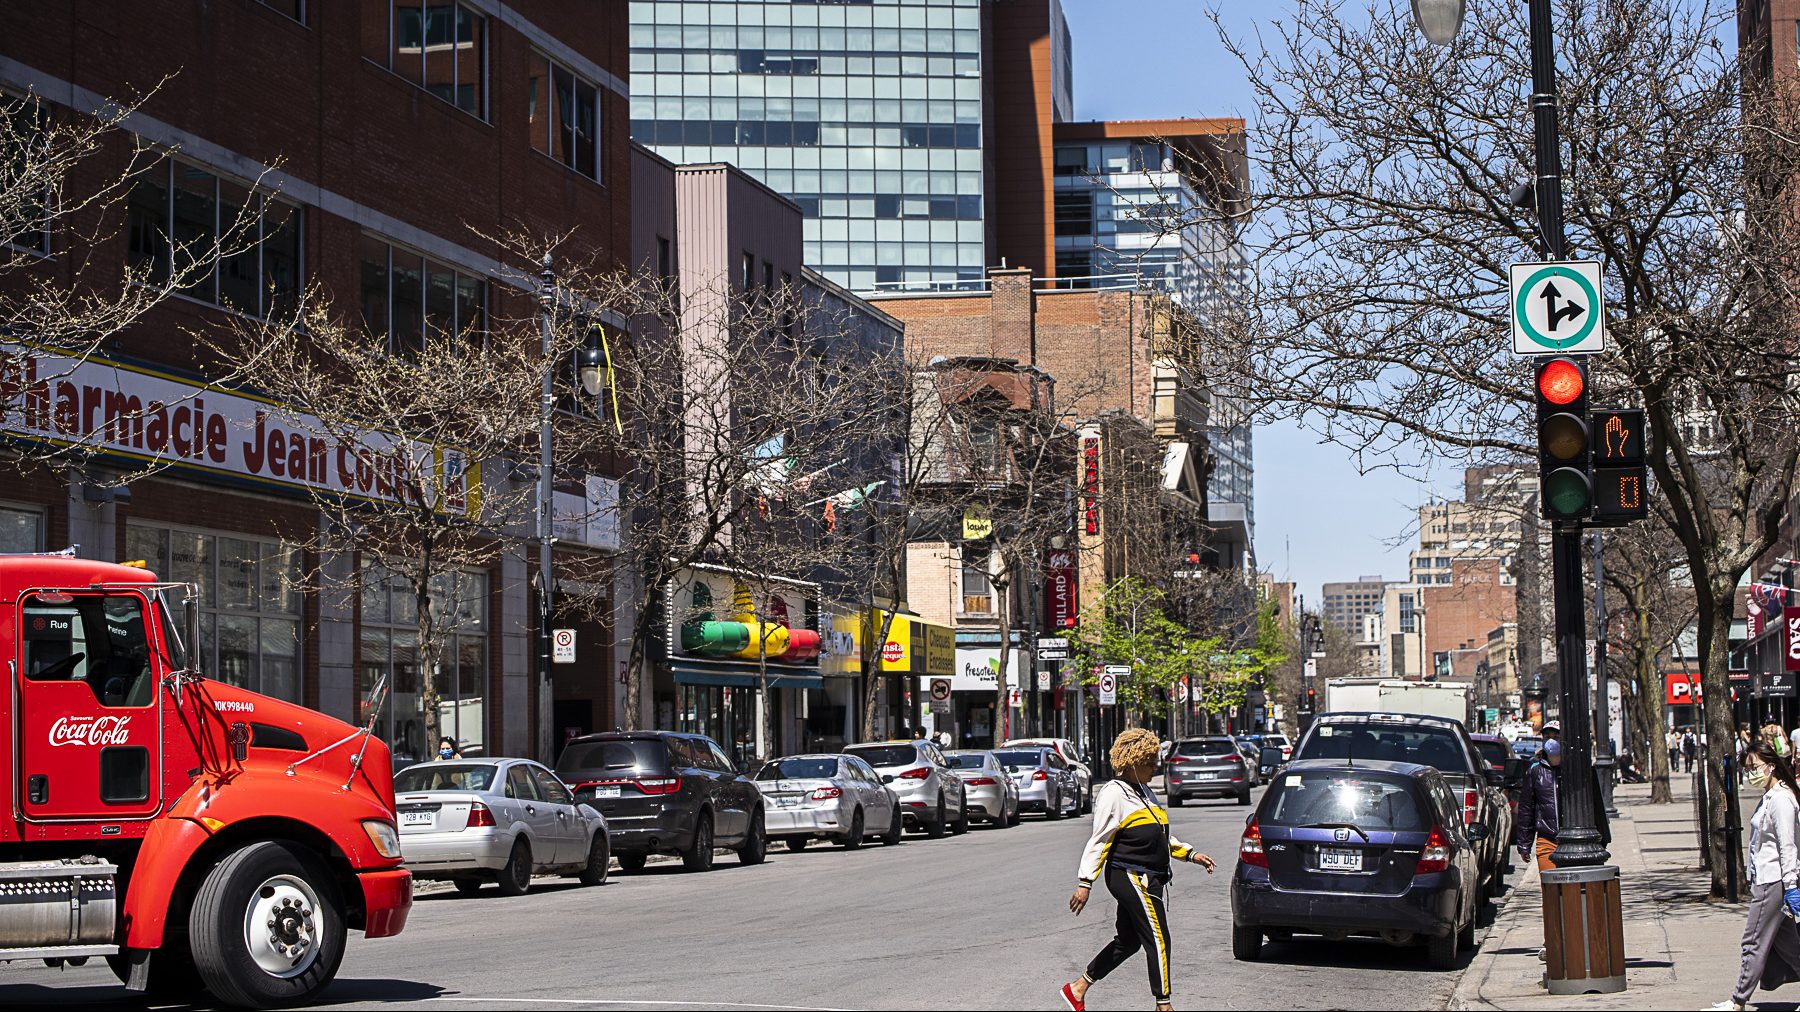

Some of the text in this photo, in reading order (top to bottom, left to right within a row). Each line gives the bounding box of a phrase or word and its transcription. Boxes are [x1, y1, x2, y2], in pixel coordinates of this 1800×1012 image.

[243, 411, 327, 484] Jean
[1621, 476, 1639, 508] 0
[967, 521, 988, 531] louer
[1056, 575, 1066, 626] BILLARD
[50, 620, 68, 629] Rue
[882, 643, 904, 652] nsta
[48, 715, 132, 747] Coca-Cola
[1322, 853, 1360, 866] W90 DEF
